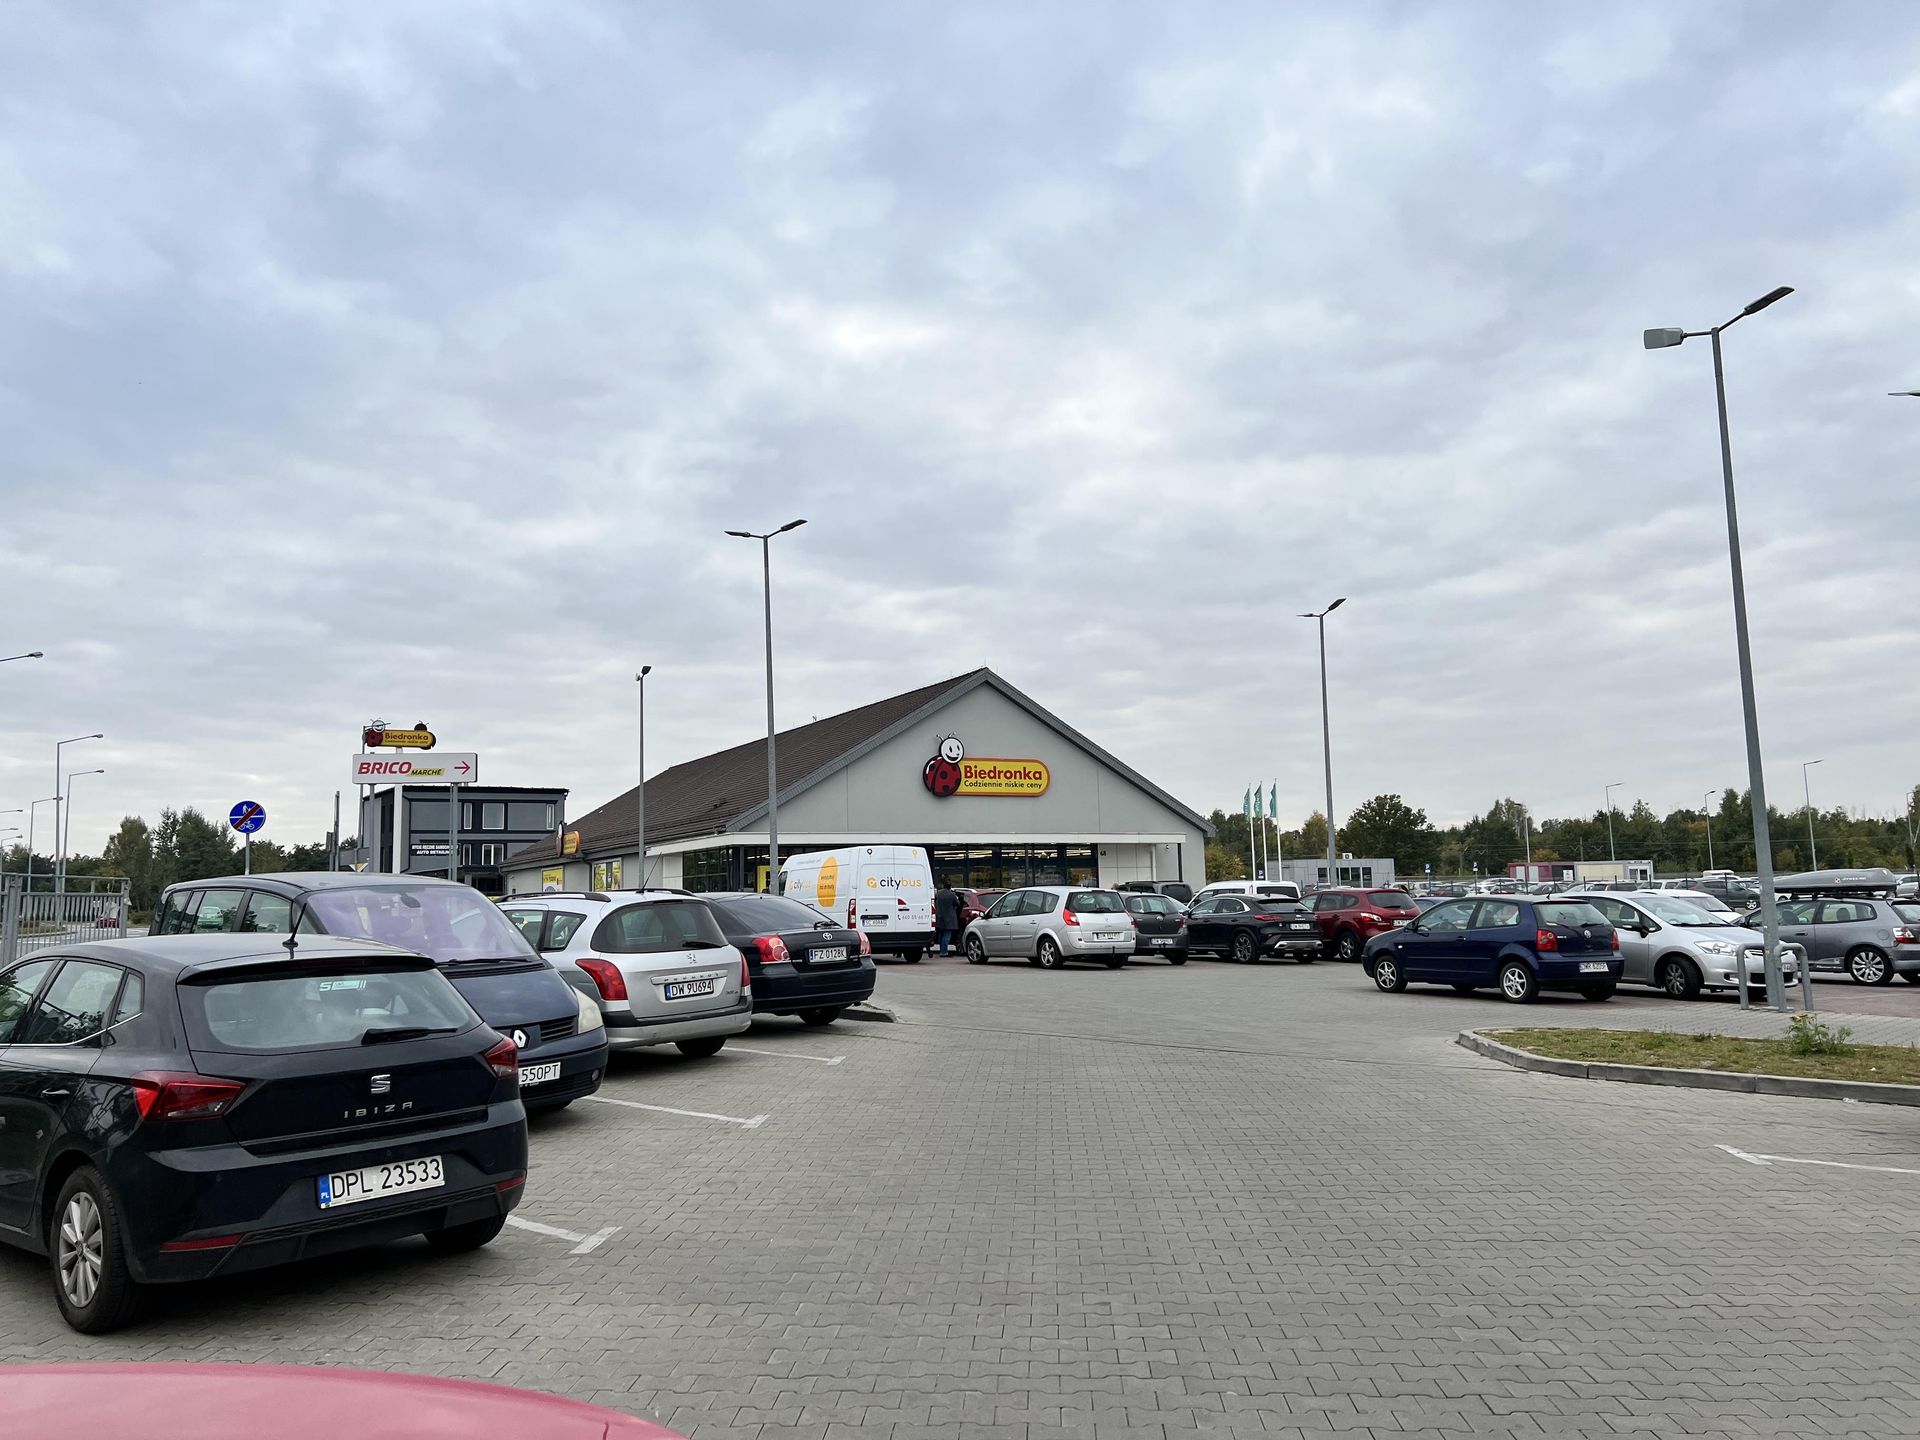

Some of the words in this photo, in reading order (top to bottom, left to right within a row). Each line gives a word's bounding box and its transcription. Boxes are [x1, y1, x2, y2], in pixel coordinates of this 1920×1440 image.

[384, 732, 429, 740] Biedronka
[358, 762, 412, 774] BRICO
[964, 765, 1042, 780] Biedronka
[964, 780, 1003, 788] Codziennie
[1004, 780, 1024, 788] niskie
[880, 876, 922, 890] citybus
[814, 950, 824, 959] FZ
[672, 984, 684, 996] DW
[687, 980, 712, 994] 9U694
[522, 1064, 558, 1082] 550PT
[344, 1102, 412, 1118] IBIZA
[331, 1170, 374, 1199] DPL
[380, 1158, 440, 1190] 23533
